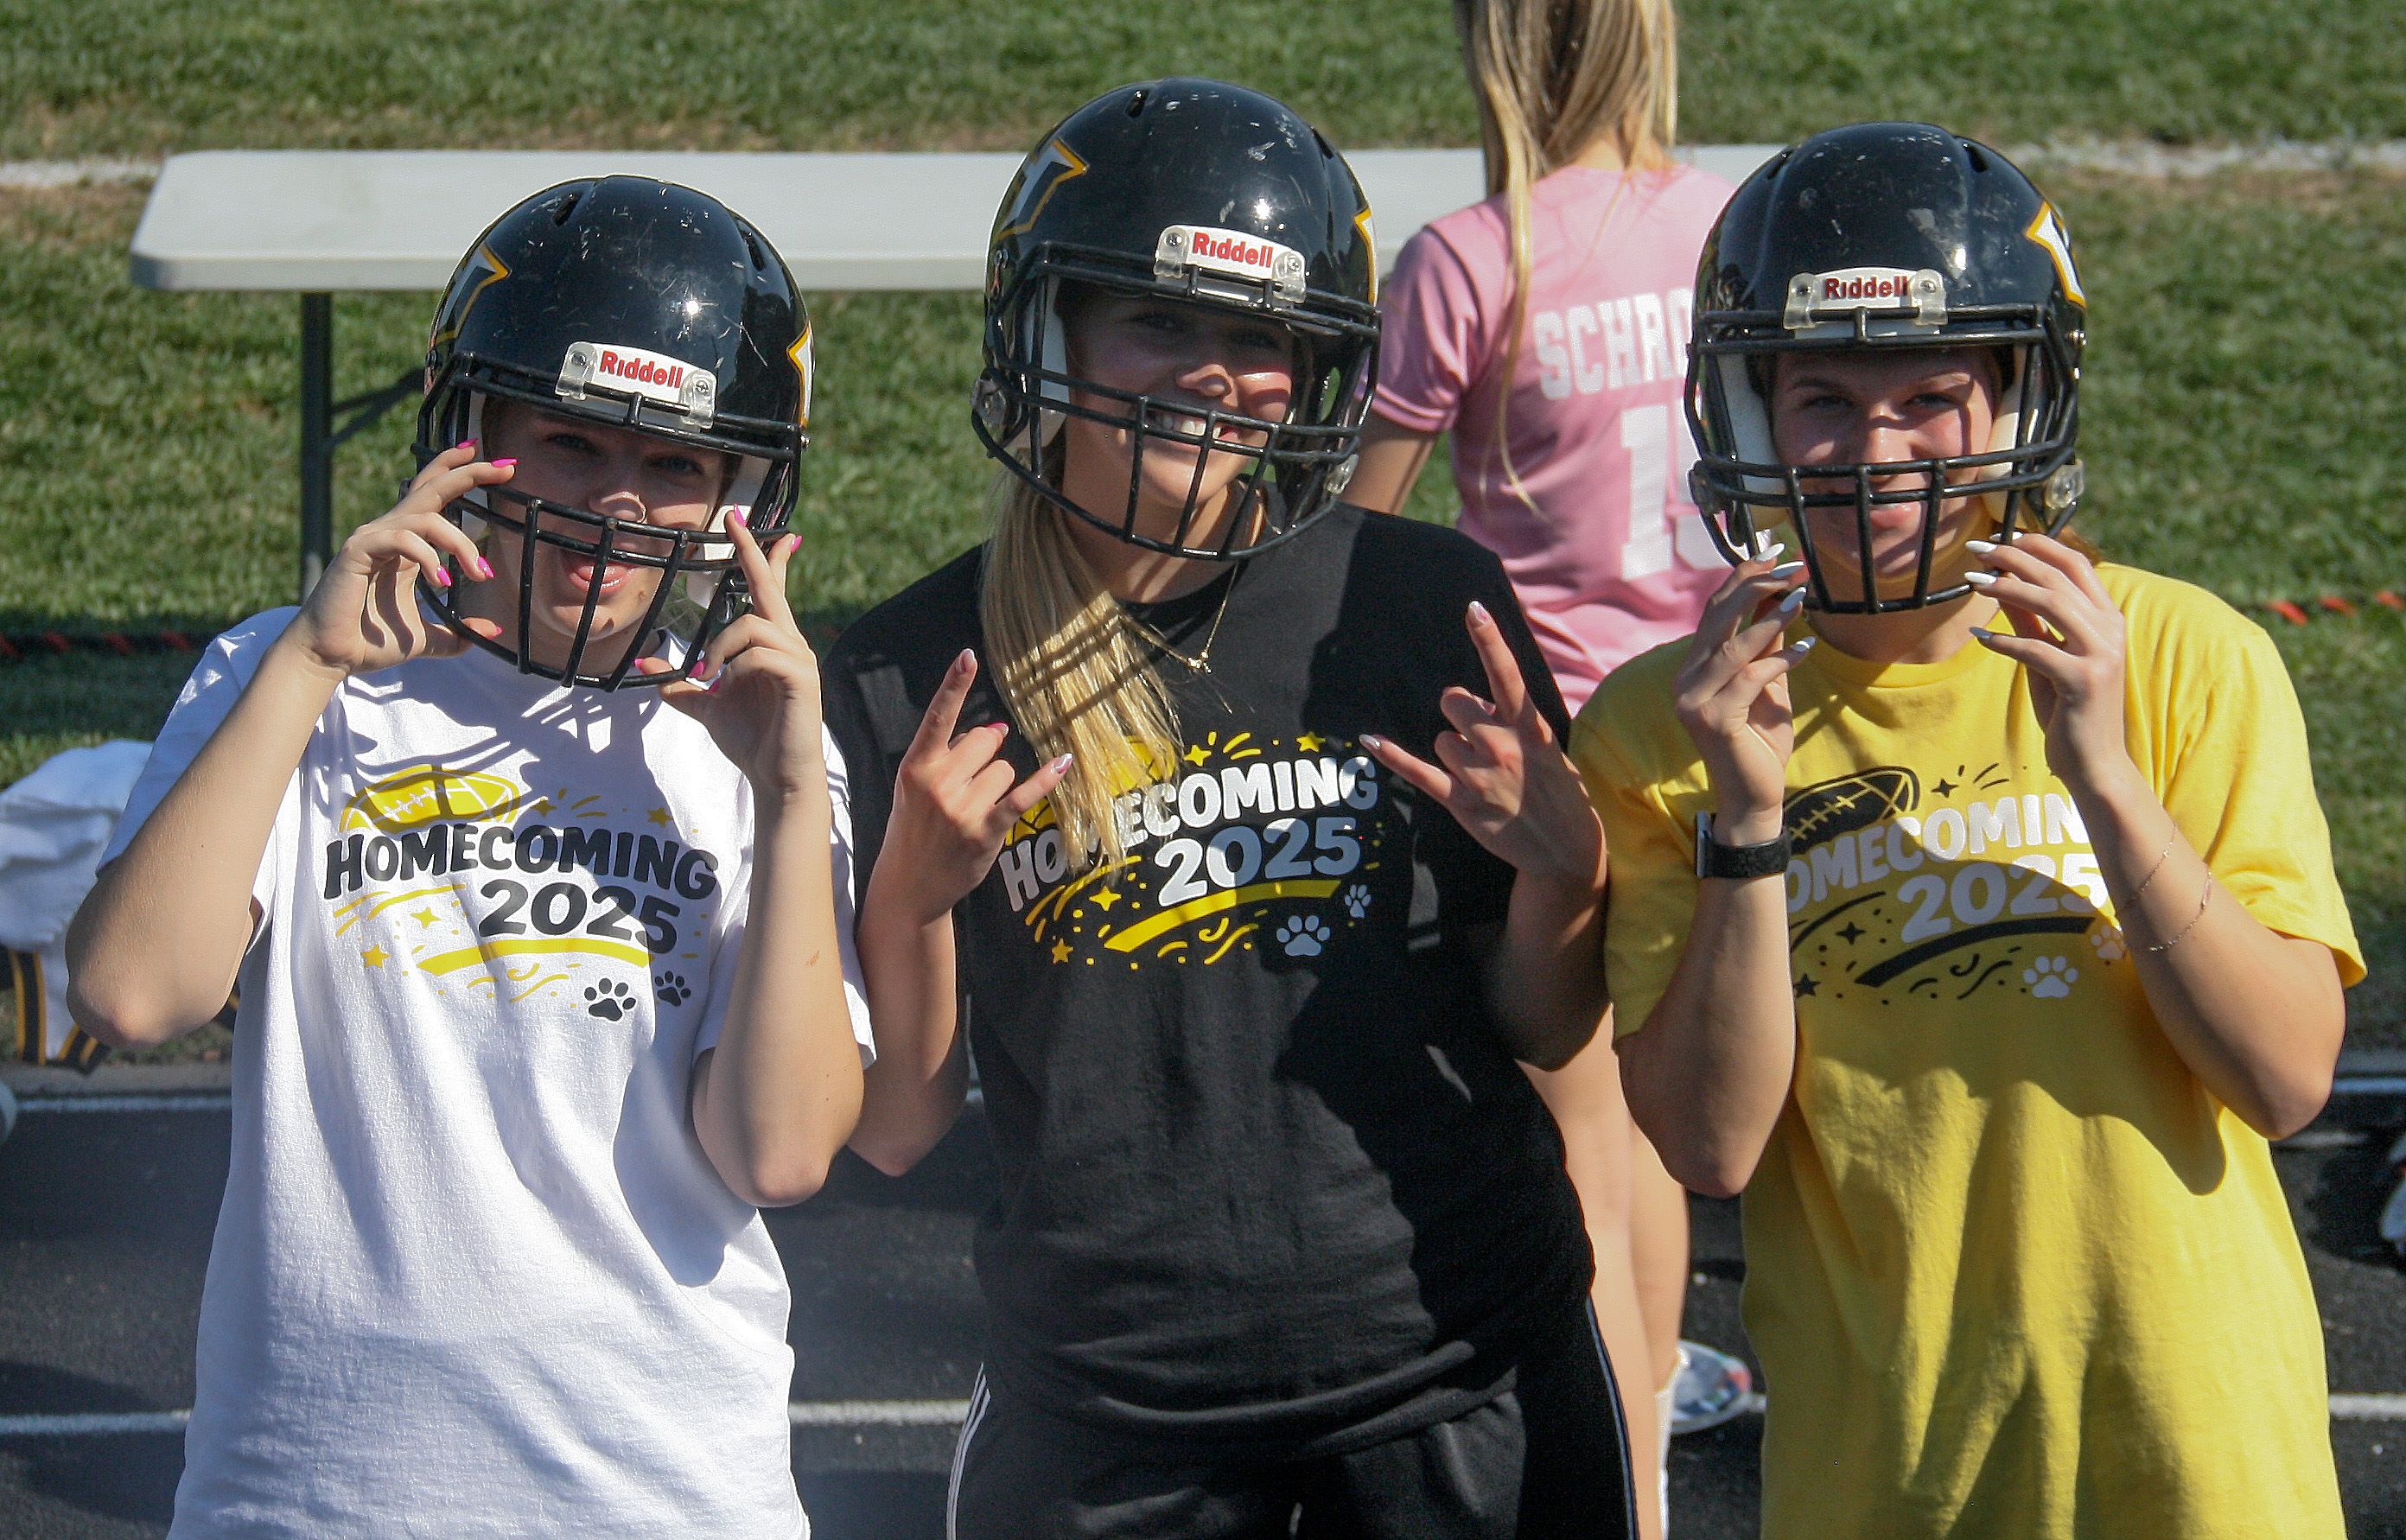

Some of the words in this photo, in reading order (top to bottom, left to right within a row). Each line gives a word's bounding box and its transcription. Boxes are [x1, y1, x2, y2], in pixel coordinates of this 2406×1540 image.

[1191, 230, 1275, 269] Riddell
[1824, 276, 1908, 299] Riddell
[599, 350, 684, 389] Riddell
[324, 824, 719, 900] HOMECOMING
[998, 756, 1378, 913] HOECOMING
[1154, 816, 1361, 907] 2025
[1785, 793, 2090, 913] OMECOMIN
[479, 879, 682, 954] 2025
[1897, 854, 2110, 944] 2025
